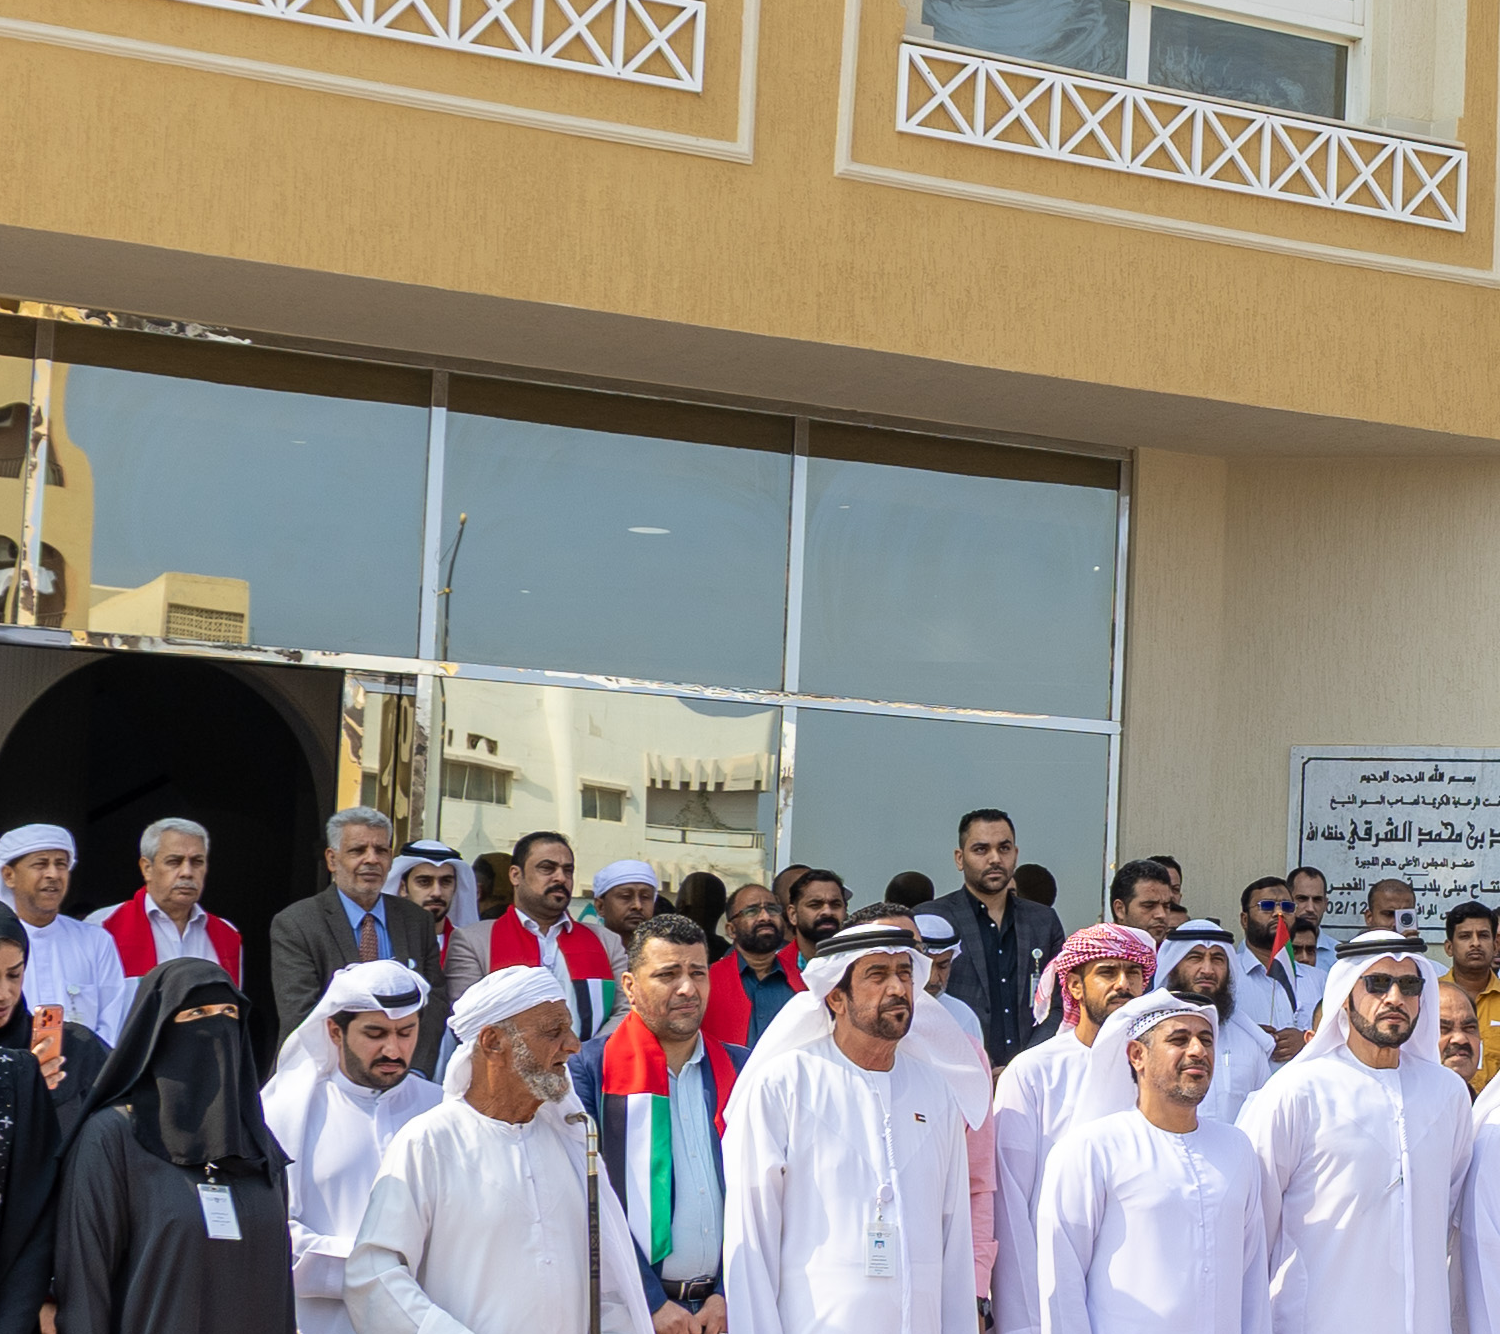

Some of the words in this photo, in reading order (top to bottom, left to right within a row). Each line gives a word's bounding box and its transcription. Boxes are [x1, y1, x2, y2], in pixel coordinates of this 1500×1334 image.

[1360, 770, 1390, 783] الرحيم
[1392, 771, 1425, 783] الرحمن
[1428, 764, 1444, 782] الله
[1447, 775, 1477, 785] بسم
[1329, 793, 1357, 810] الشيخ
[1358, 794, 1386, 808] السمو
[1387, 794, 1420, 808] لصاحب
[1421, 793, 1451, 810] الكريمة
[1452, 795, 1481, 810] الرعاية
[1306, 821, 1319, 841] الله
[1321, 824, 1346, 841] حفظه
[1347, 816, 1413, 850] الشرقي
[1417, 820, 1463, 848] محمد
[1465, 820, 1486, 850] بن
[1355, 856, 1379, 870] الفجيرة
[1381, 857, 1397, 870] حاكم
[1398, 855, 1420, 871] الأعلى
[1422, 857, 1449, 870] المجلس
[1450, 858, 1476, 870] عضو
[1326, 877, 1366, 895] الفجير
[1443, 879, 1467, 899] مبنى
